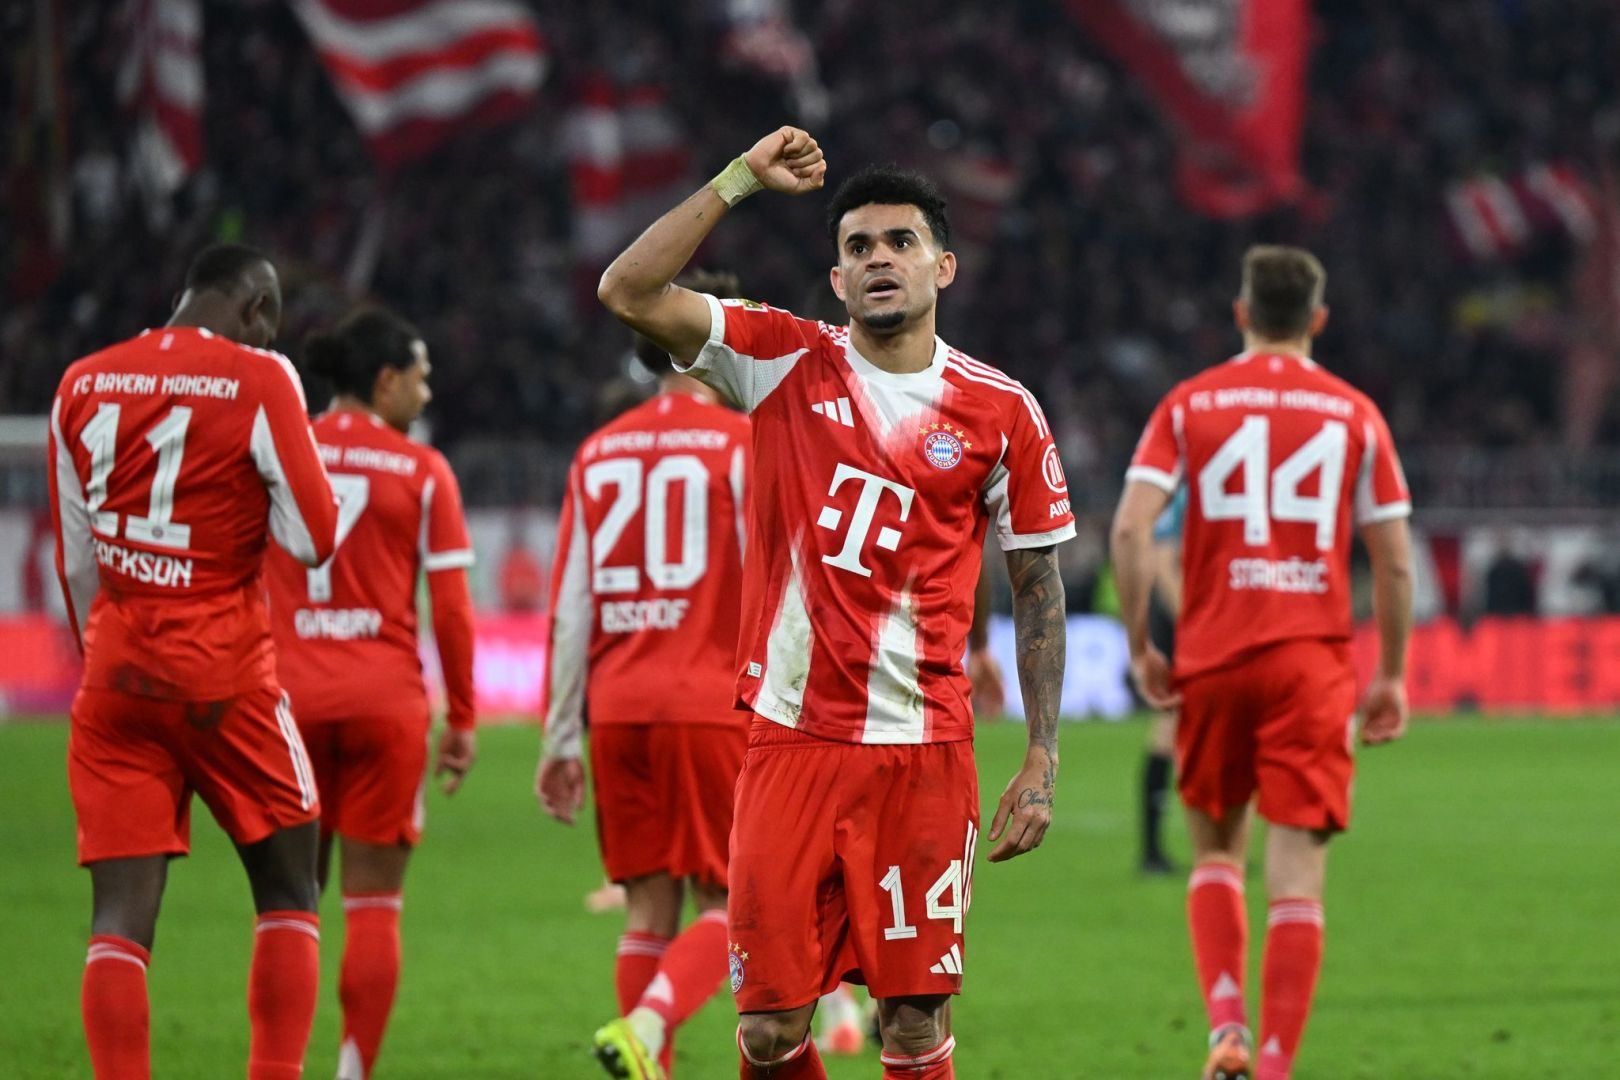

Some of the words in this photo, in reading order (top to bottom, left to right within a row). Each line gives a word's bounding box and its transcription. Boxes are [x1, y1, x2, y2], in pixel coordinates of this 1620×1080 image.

[73, 374, 92, 396] FC
[94, 372, 156, 394] BAYERN
[161, 374, 239, 400] MÜNCHEN
[80, 402, 192, 550] 11
[306, 474, 369, 602] 7
[584, 455, 709, 593] 20
[1200, 415, 1348, 550] 44
[94, 537, 193, 588] ACKSON
[880, 860, 962, 940] 14
